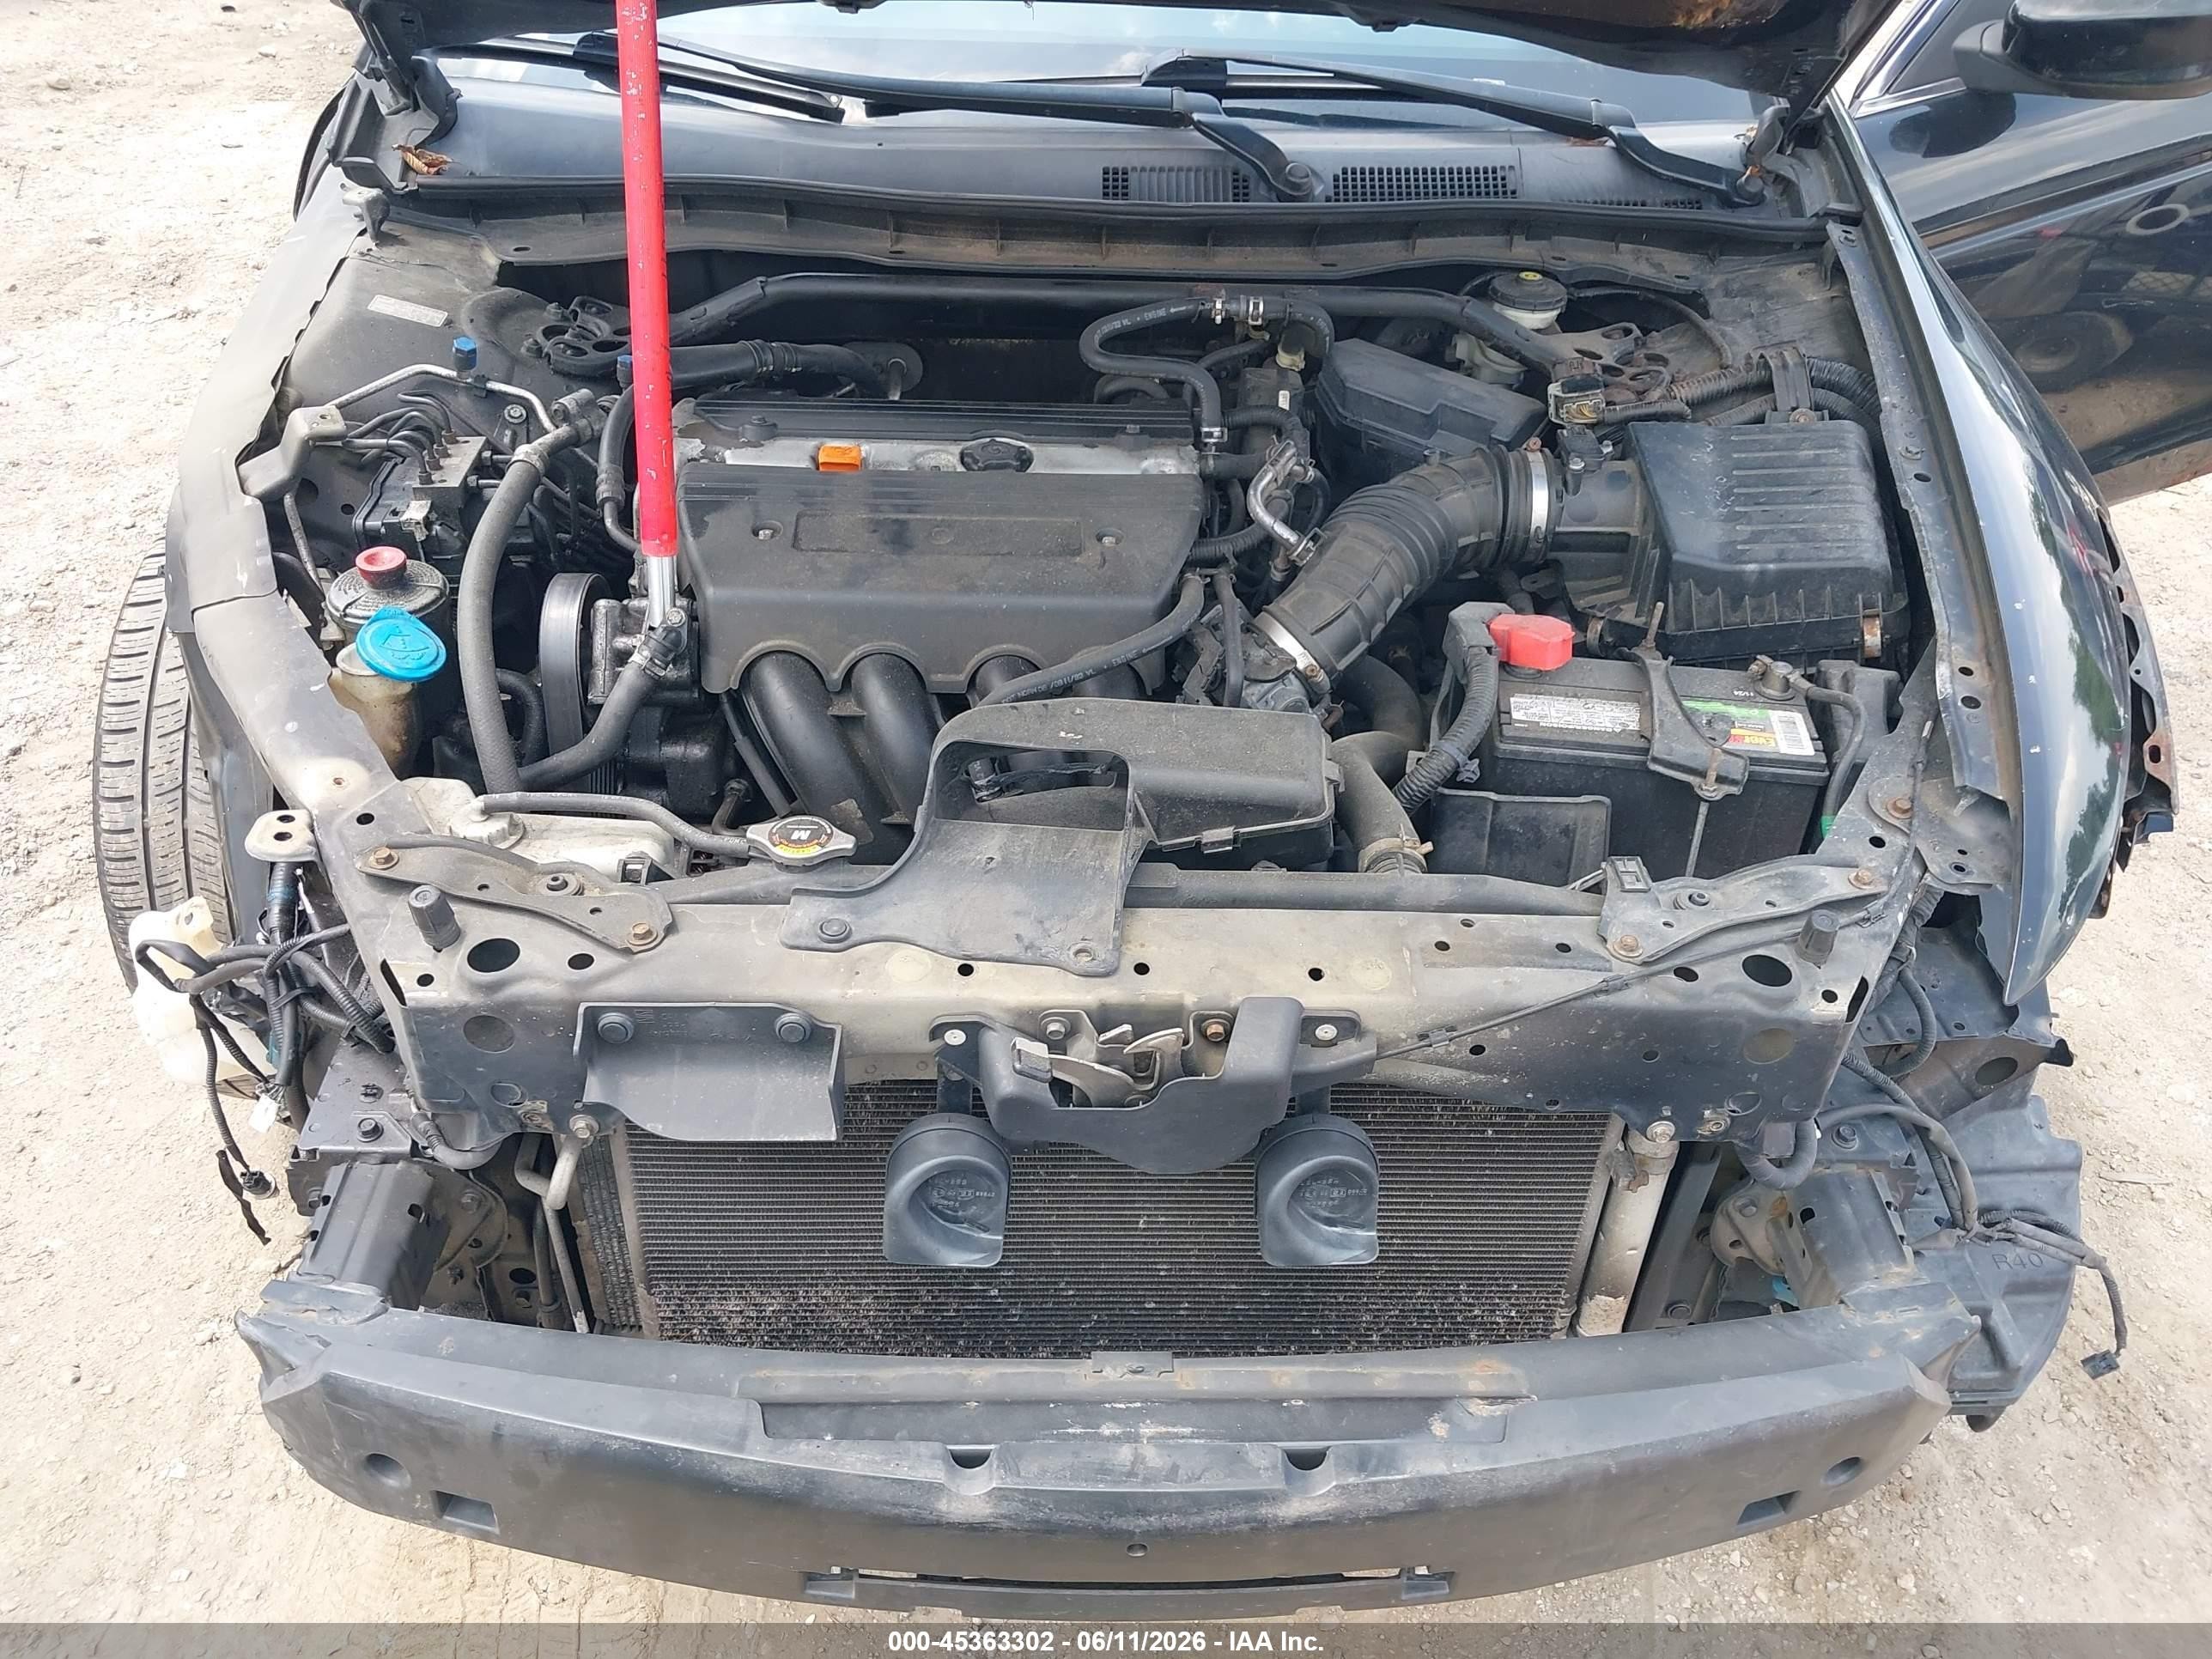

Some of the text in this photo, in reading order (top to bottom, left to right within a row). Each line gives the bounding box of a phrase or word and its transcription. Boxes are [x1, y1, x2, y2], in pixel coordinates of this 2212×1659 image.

[1144, 307, 1167, 321] ENGINE
[1111, 650, 1139, 666] ENGINE
[1992, 1253, 2044, 1270] R40
